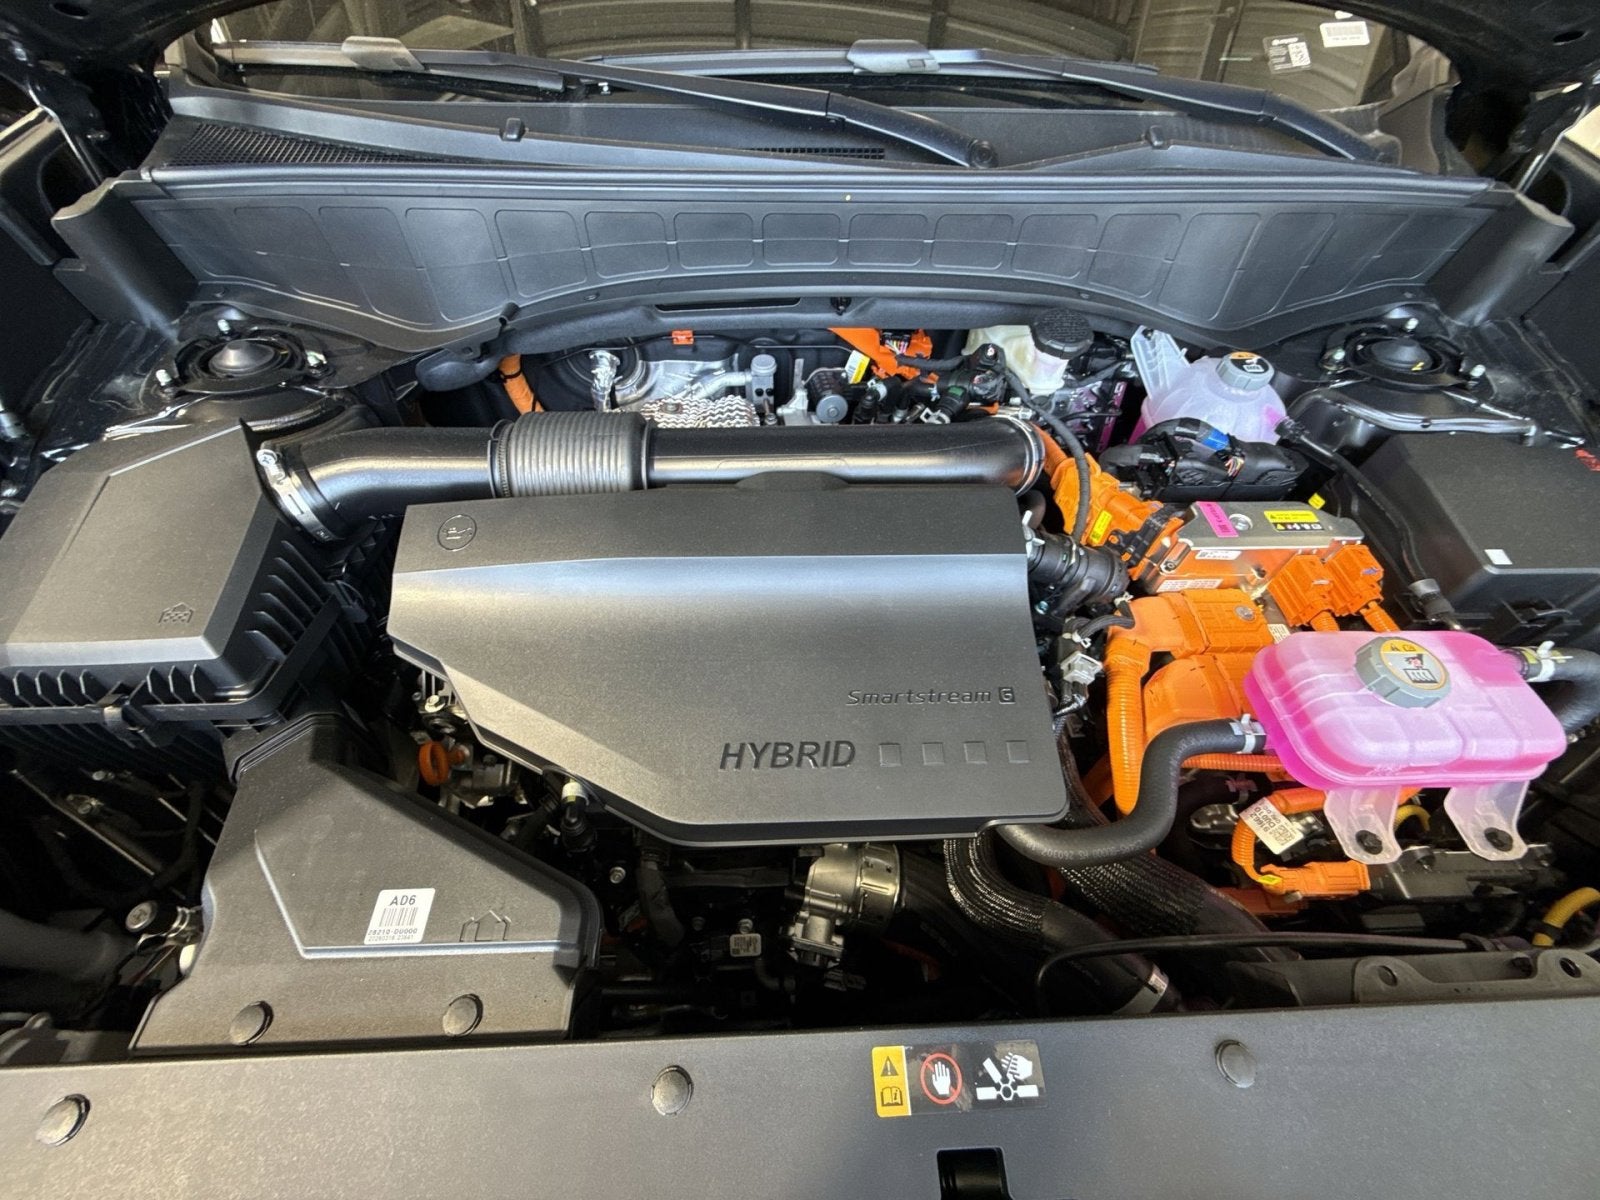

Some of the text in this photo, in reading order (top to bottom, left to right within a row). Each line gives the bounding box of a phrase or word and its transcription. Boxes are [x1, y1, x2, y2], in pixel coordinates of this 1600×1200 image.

[846, 688, 991, 706] Smartstream
[719, 740, 856, 770] HYBRID
[389, 895, 416, 905] AD6
